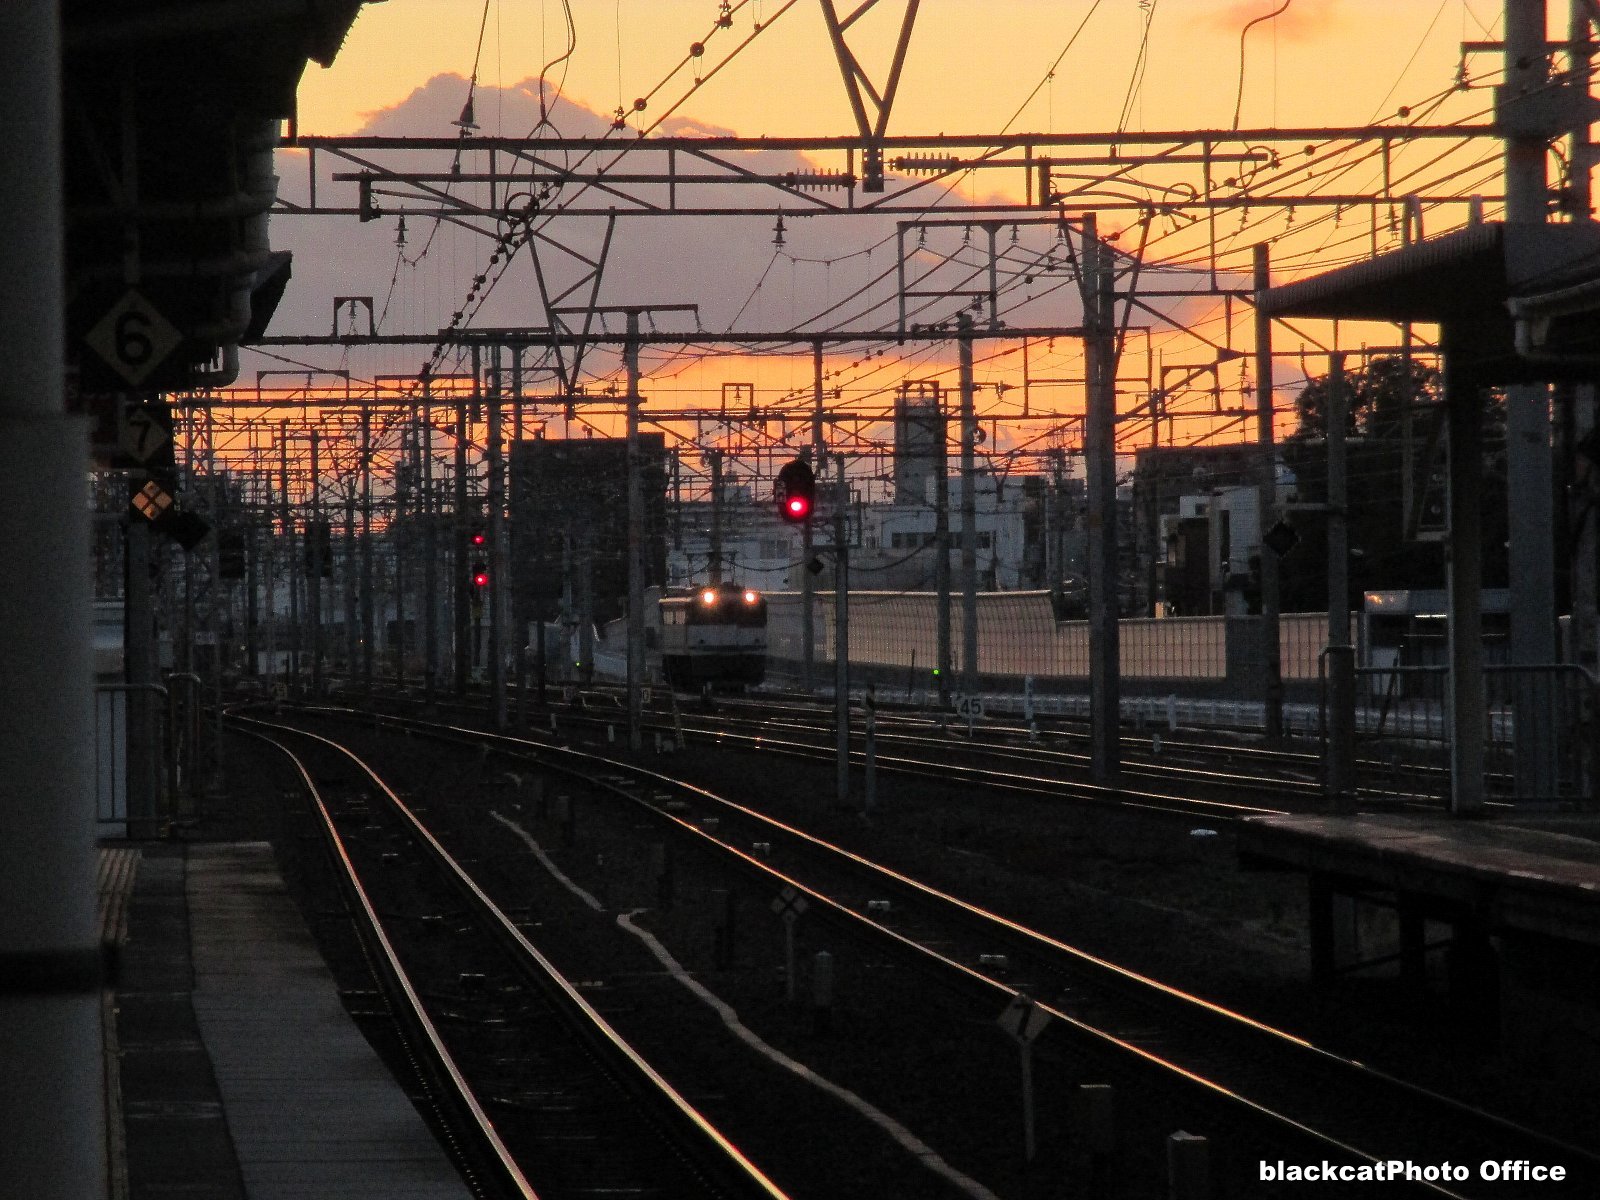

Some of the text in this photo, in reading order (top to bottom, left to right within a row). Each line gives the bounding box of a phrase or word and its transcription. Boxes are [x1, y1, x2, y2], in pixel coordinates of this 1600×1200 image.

[115, 312, 152, 365] 6
[130, 420, 151, 452] 7
[960, 698, 982, 715] 45
[1013, 1000, 1033, 1036] 7
